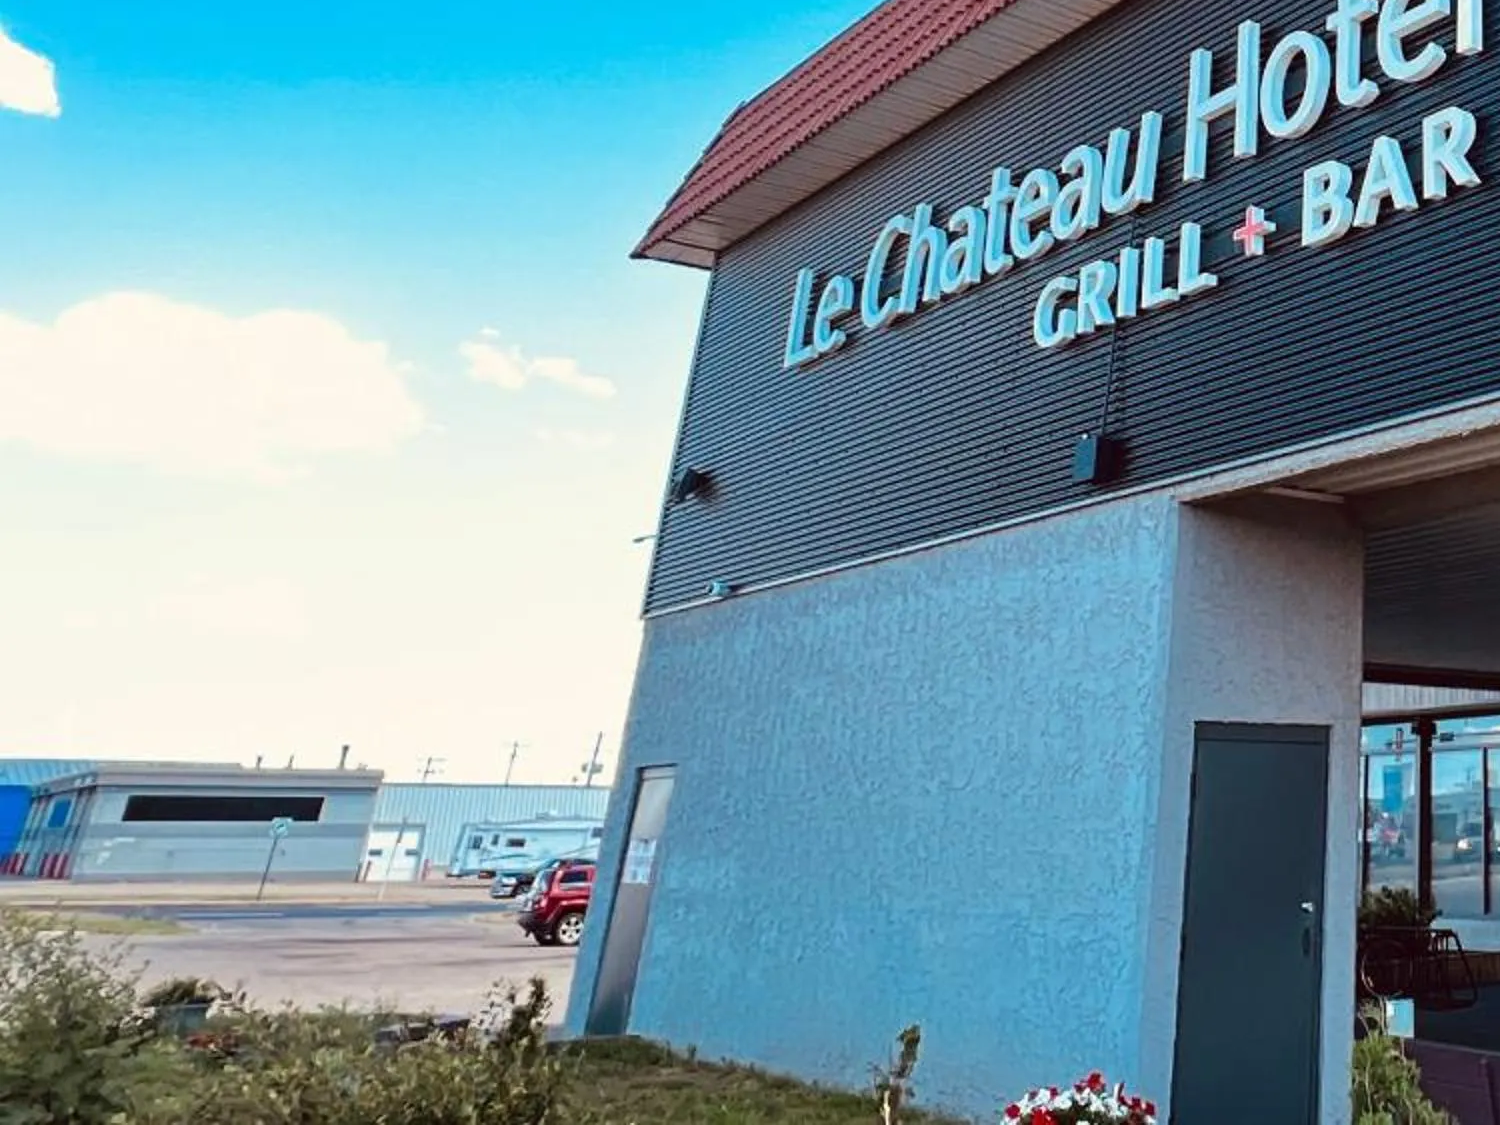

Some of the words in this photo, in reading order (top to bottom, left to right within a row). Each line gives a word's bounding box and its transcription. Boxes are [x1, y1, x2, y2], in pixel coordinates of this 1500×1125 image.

[784, 267, 854, 367] Le
[861, 111, 1162, 328] Chateau
[1033, 222, 1218, 348] GRILL
[1302, 106, 1482, 247] BAR
